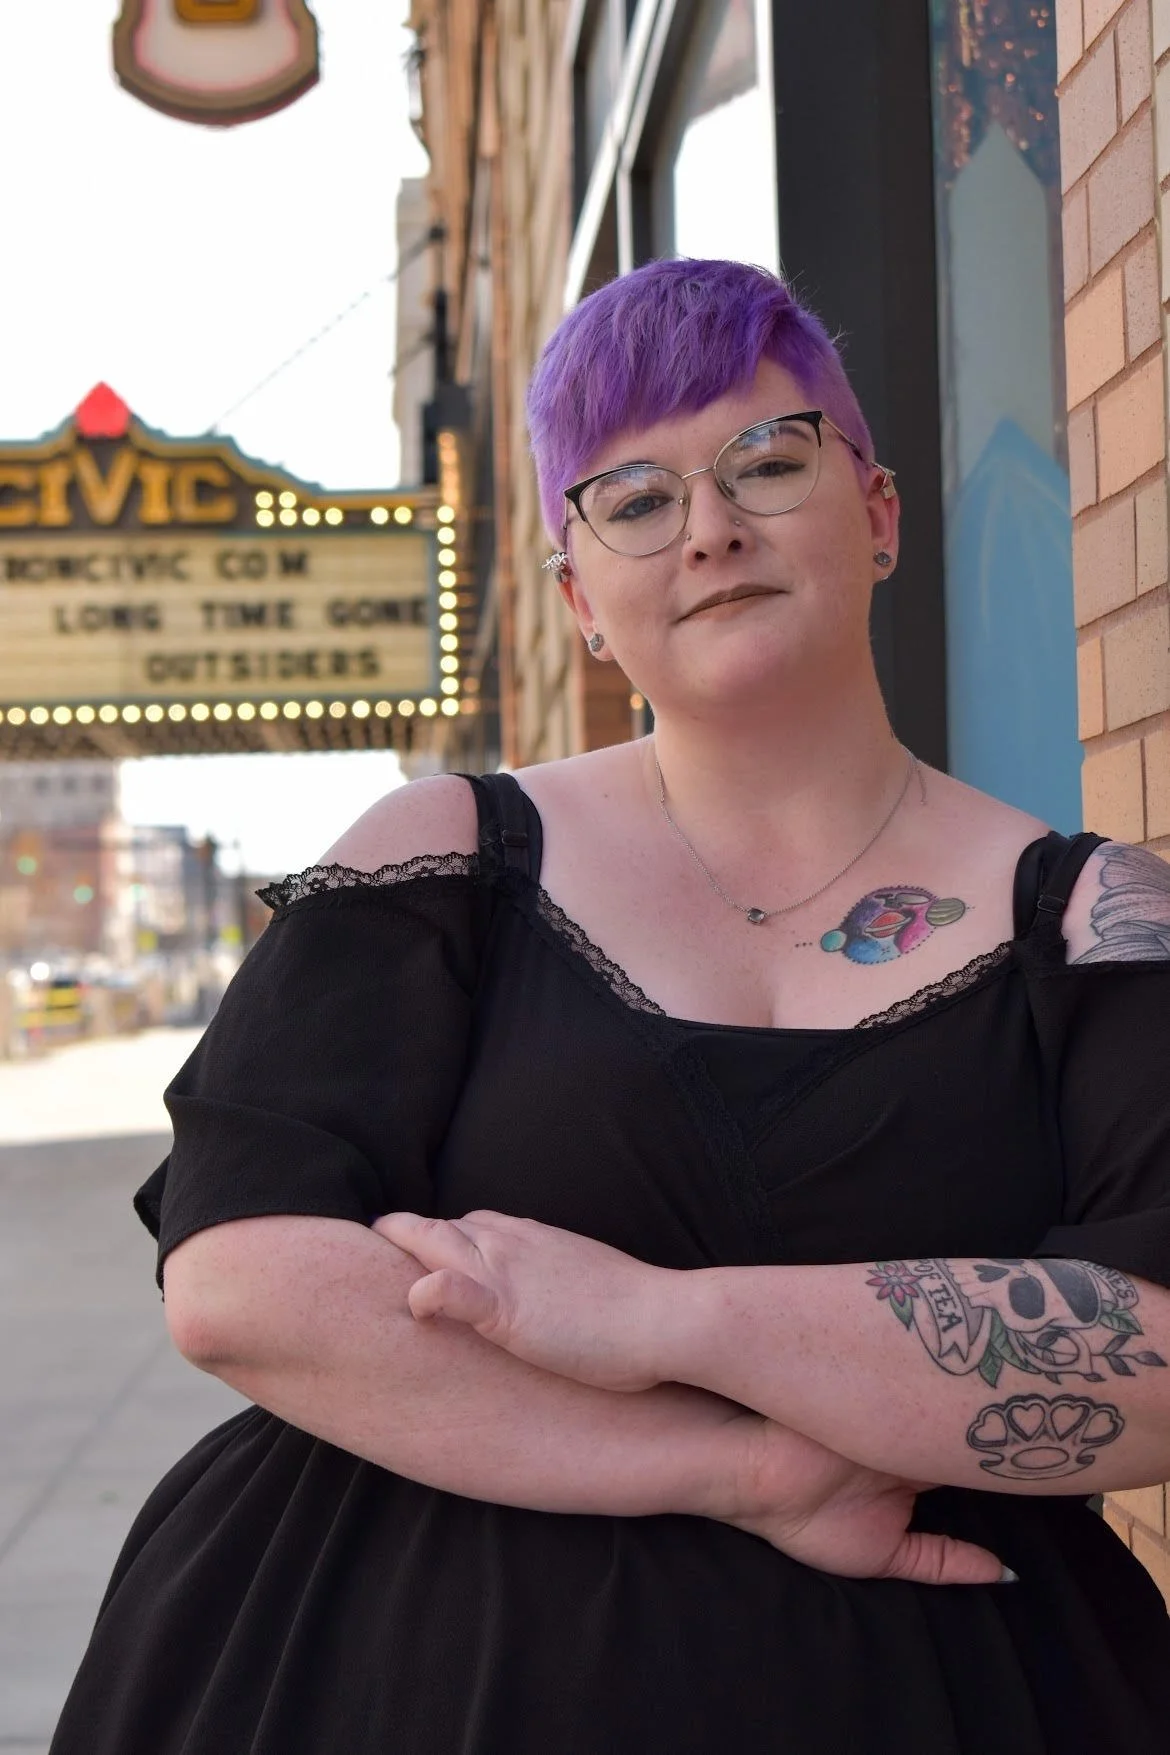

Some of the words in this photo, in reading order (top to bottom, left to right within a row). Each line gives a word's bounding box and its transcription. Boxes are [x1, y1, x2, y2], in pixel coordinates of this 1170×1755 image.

[214, 548, 308, 582] COM
[54, 603, 163, 636] LONG
[201, 599, 296, 632] TIME
[325, 597, 428, 629] GONE
[146, 648, 381, 684] OUTSIDERS
[927, 1283, 962, 1333] TEA
